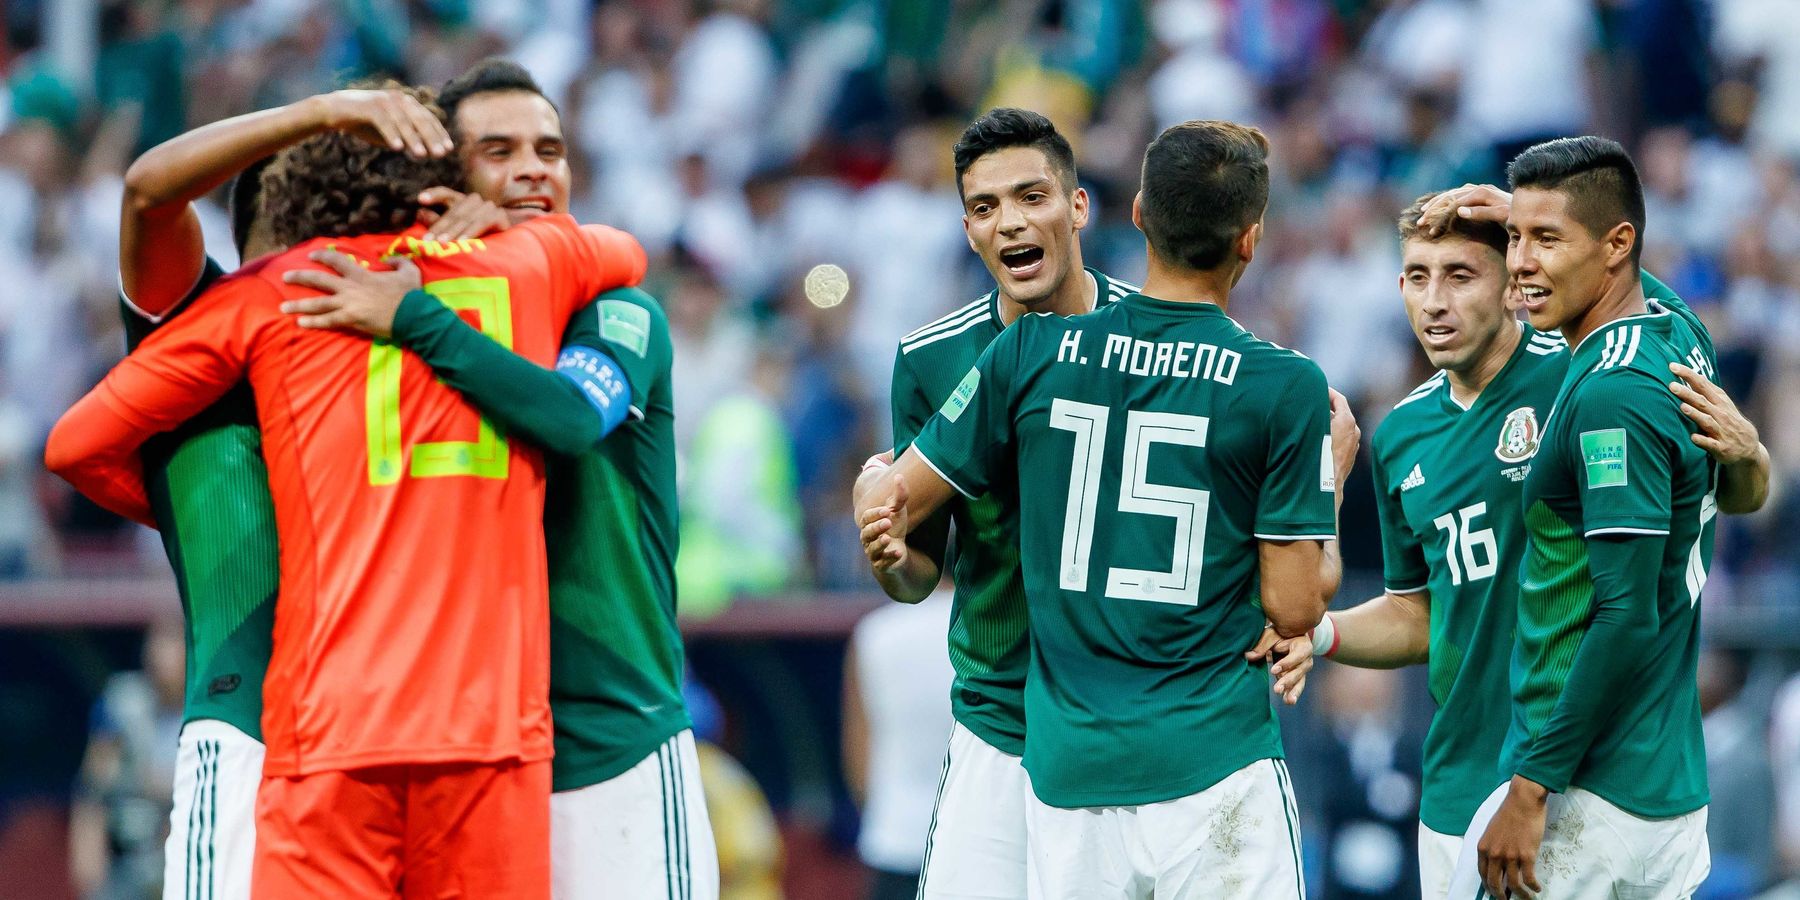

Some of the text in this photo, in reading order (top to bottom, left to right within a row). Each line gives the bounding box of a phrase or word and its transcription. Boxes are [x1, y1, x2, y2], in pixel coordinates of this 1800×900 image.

[1057, 330, 1242, 386] H. MORENO
[1049, 398, 1211, 606] 15
[1322, 480, 1334, 488] RUS
[1433, 501, 1498, 586] 16
